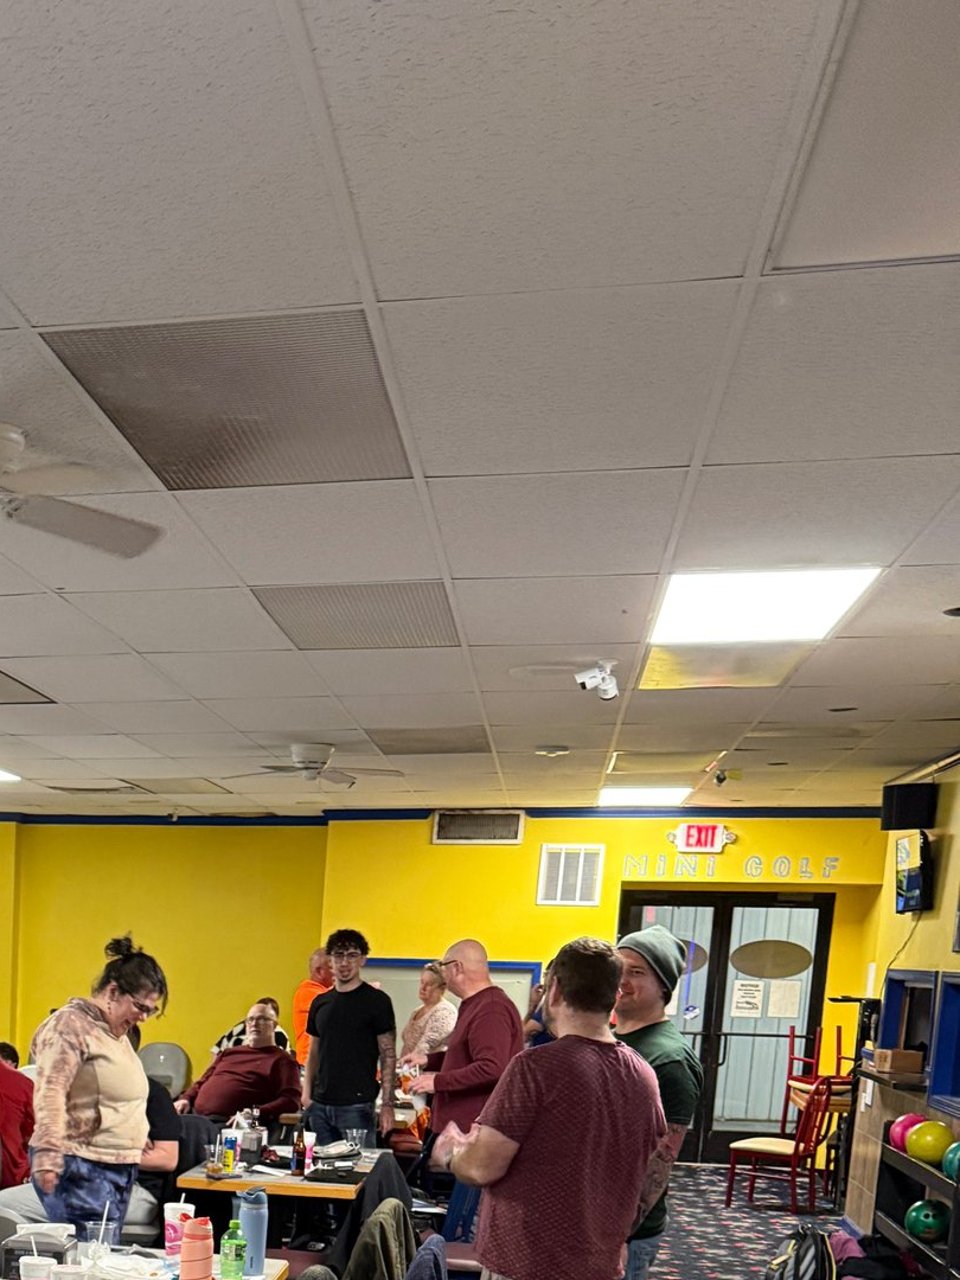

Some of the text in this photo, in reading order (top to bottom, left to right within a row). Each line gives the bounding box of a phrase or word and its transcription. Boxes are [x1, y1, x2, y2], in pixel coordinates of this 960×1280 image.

[685, 824, 718, 848] EXIT
[624, 854, 841, 879] MINI GOLF
